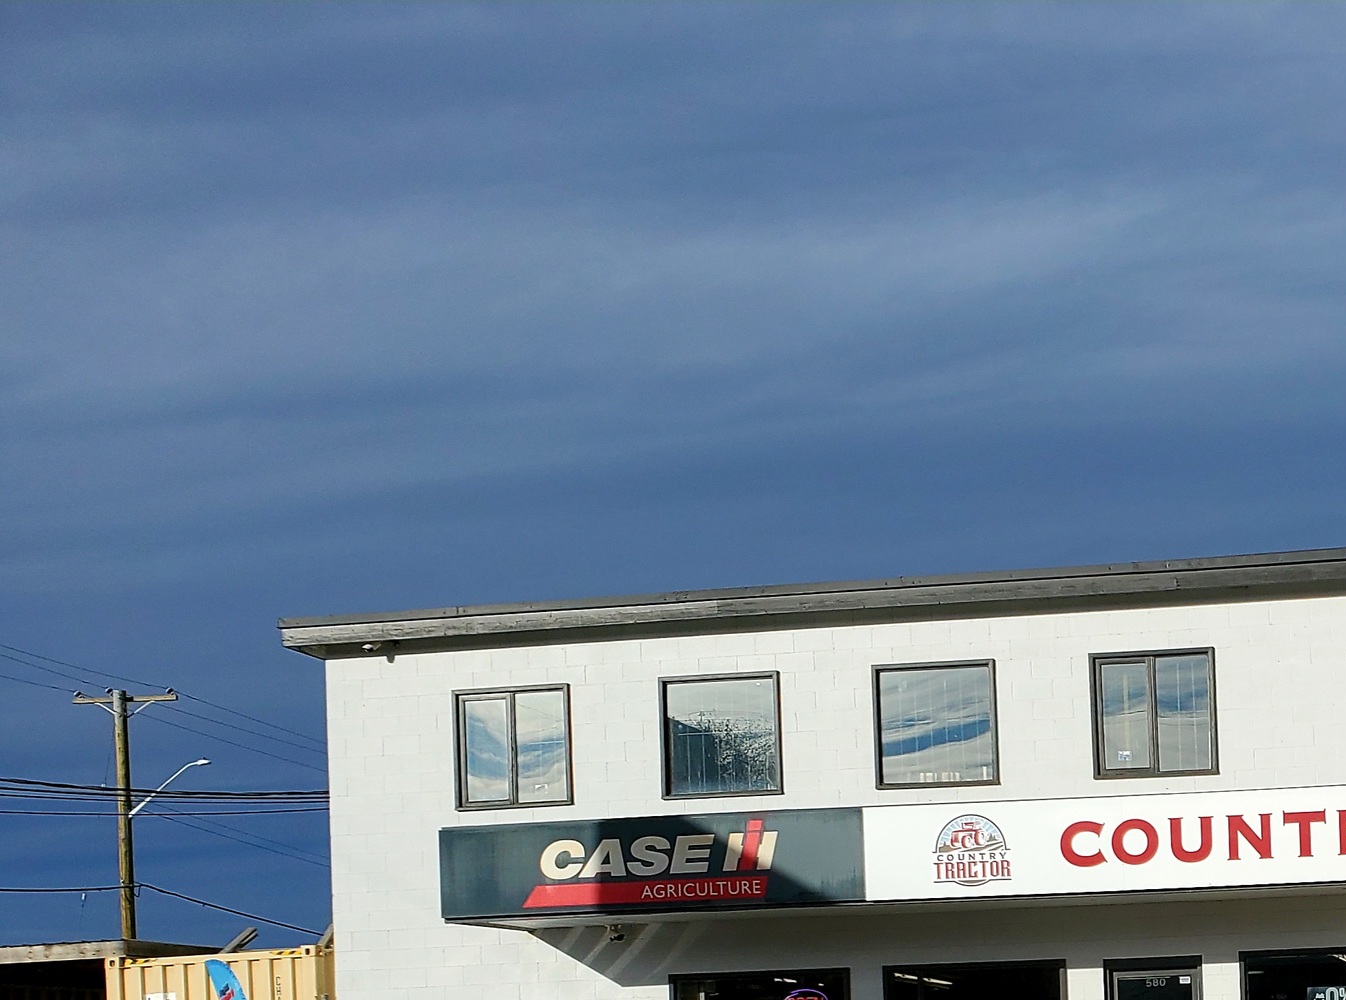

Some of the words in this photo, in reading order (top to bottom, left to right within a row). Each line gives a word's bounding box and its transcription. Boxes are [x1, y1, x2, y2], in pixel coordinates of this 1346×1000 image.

[540, 834, 715, 880] CASE
[936, 851, 1007, 862] COUNTRY
[933, 859, 1012, 879] TRACTOR
[641, 880, 761, 899] AGRICULTURE
[1146, 979, 1166, 987] 580
